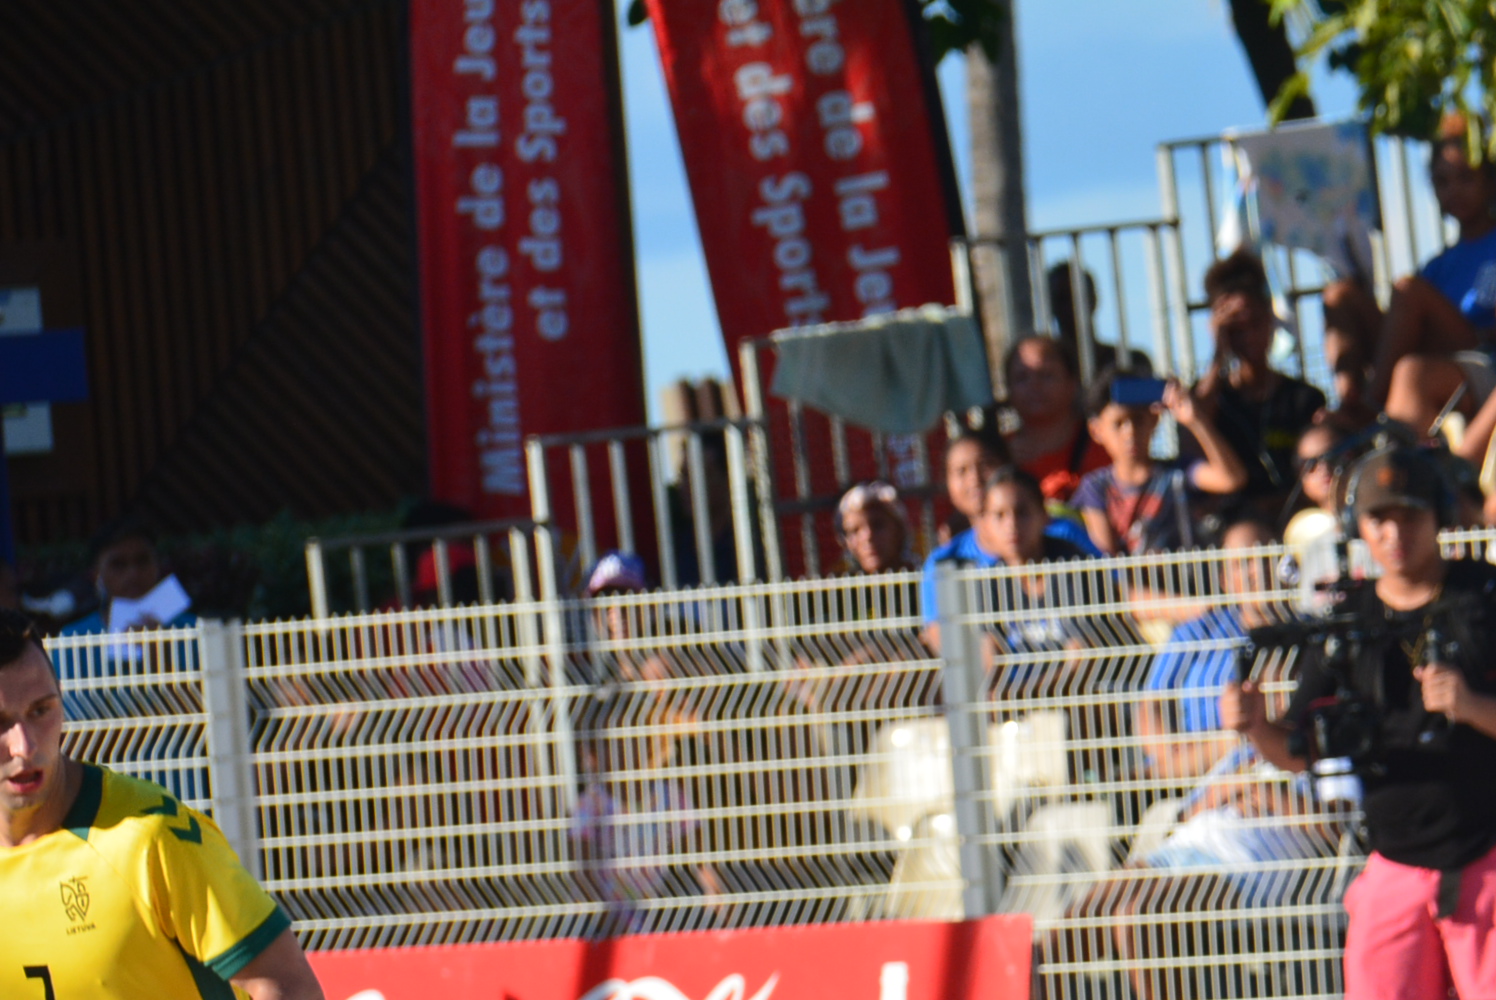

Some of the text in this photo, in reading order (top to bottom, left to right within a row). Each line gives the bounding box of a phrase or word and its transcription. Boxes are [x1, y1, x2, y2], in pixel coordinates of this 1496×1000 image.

[453, 95, 501, 147] la
[734, 61, 794, 161] des
[816, 90, 875, 162] de
[456, 162, 505, 230] de
[513, 0, 569, 341] et des Sports
[835, 170, 890, 230] la
[467, 245, 525, 494] Ministère
[66, 923, 96, 936] LIETUVA
